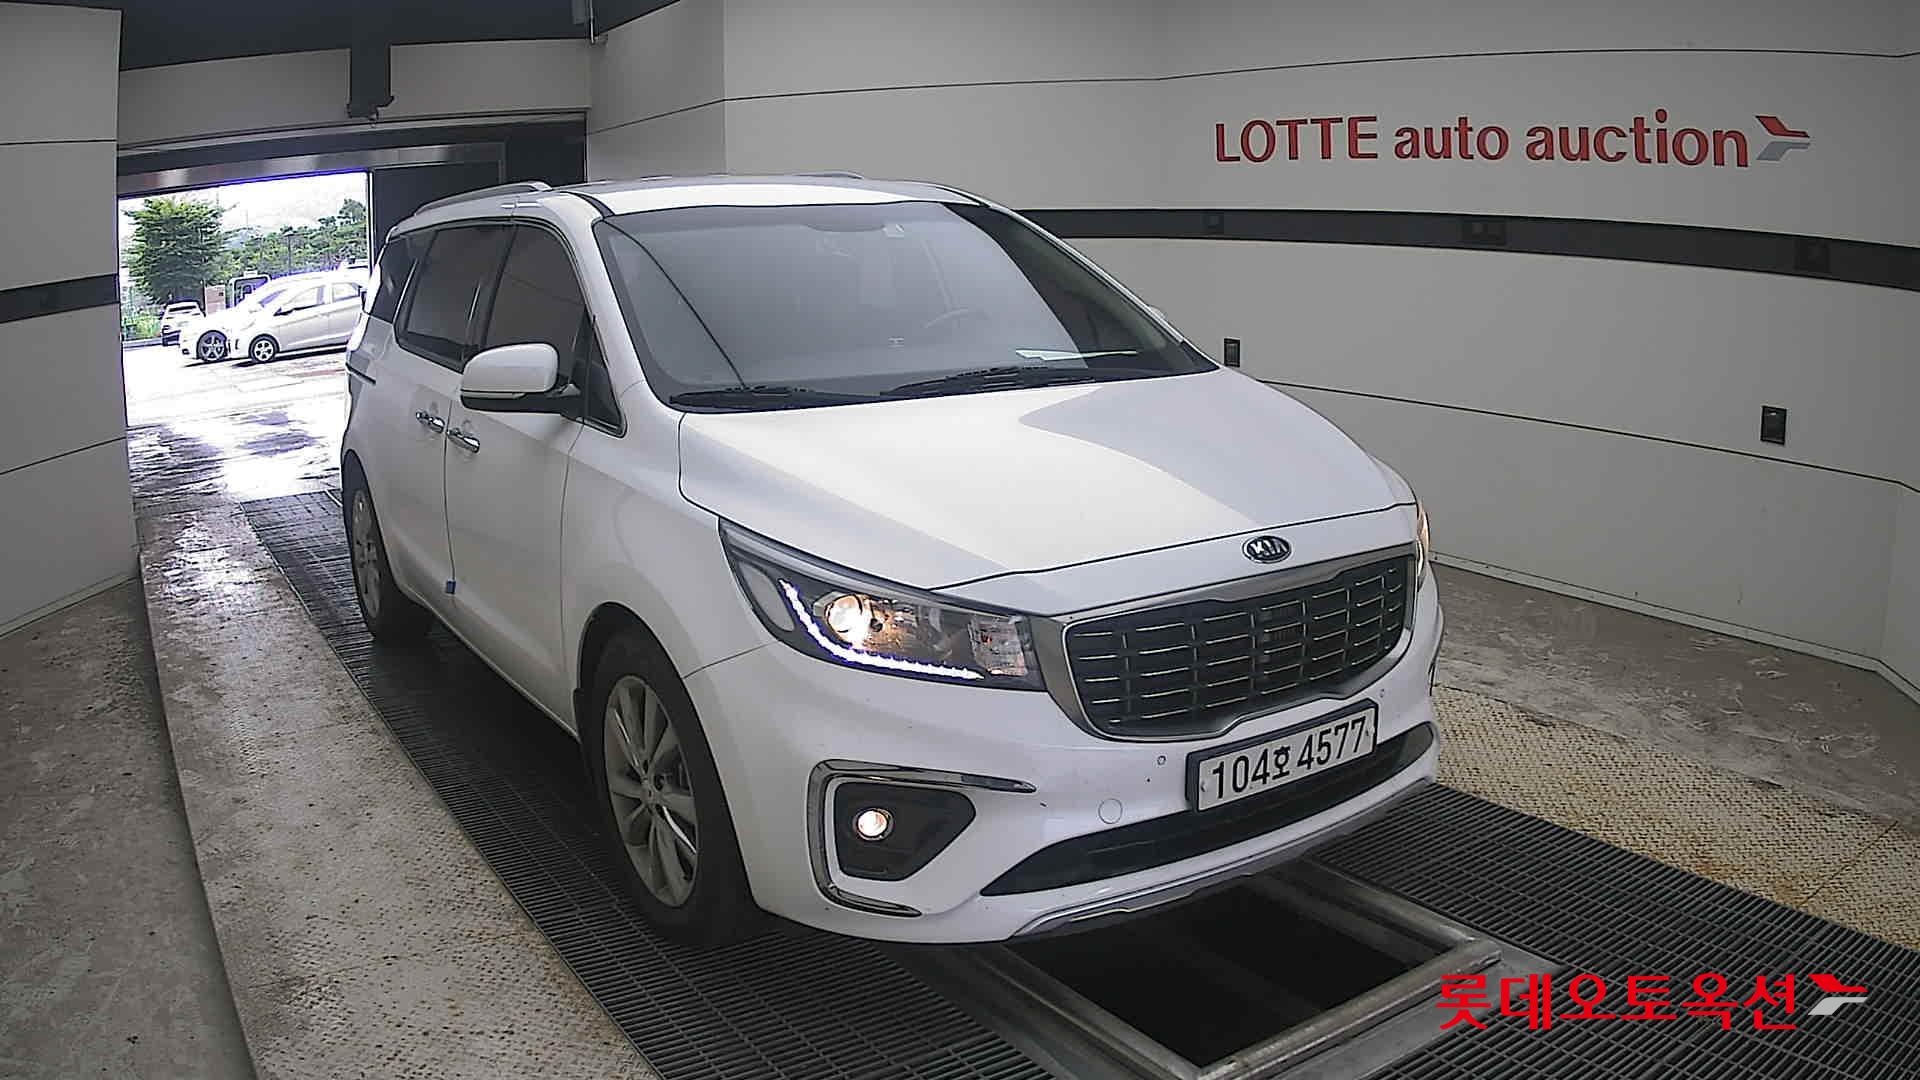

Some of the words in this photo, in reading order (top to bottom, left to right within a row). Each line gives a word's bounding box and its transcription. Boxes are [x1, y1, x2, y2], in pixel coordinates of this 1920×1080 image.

[1215, 114, 1379, 163] LOTTE
[1394, 116, 1509, 161] auto
[1525, 108, 1749, 168] auction
[1246, 537, 1289, 556] KIA
[1212, 745, 1291, 799] 104호
[1297, 716, 1367, 770] 4577
